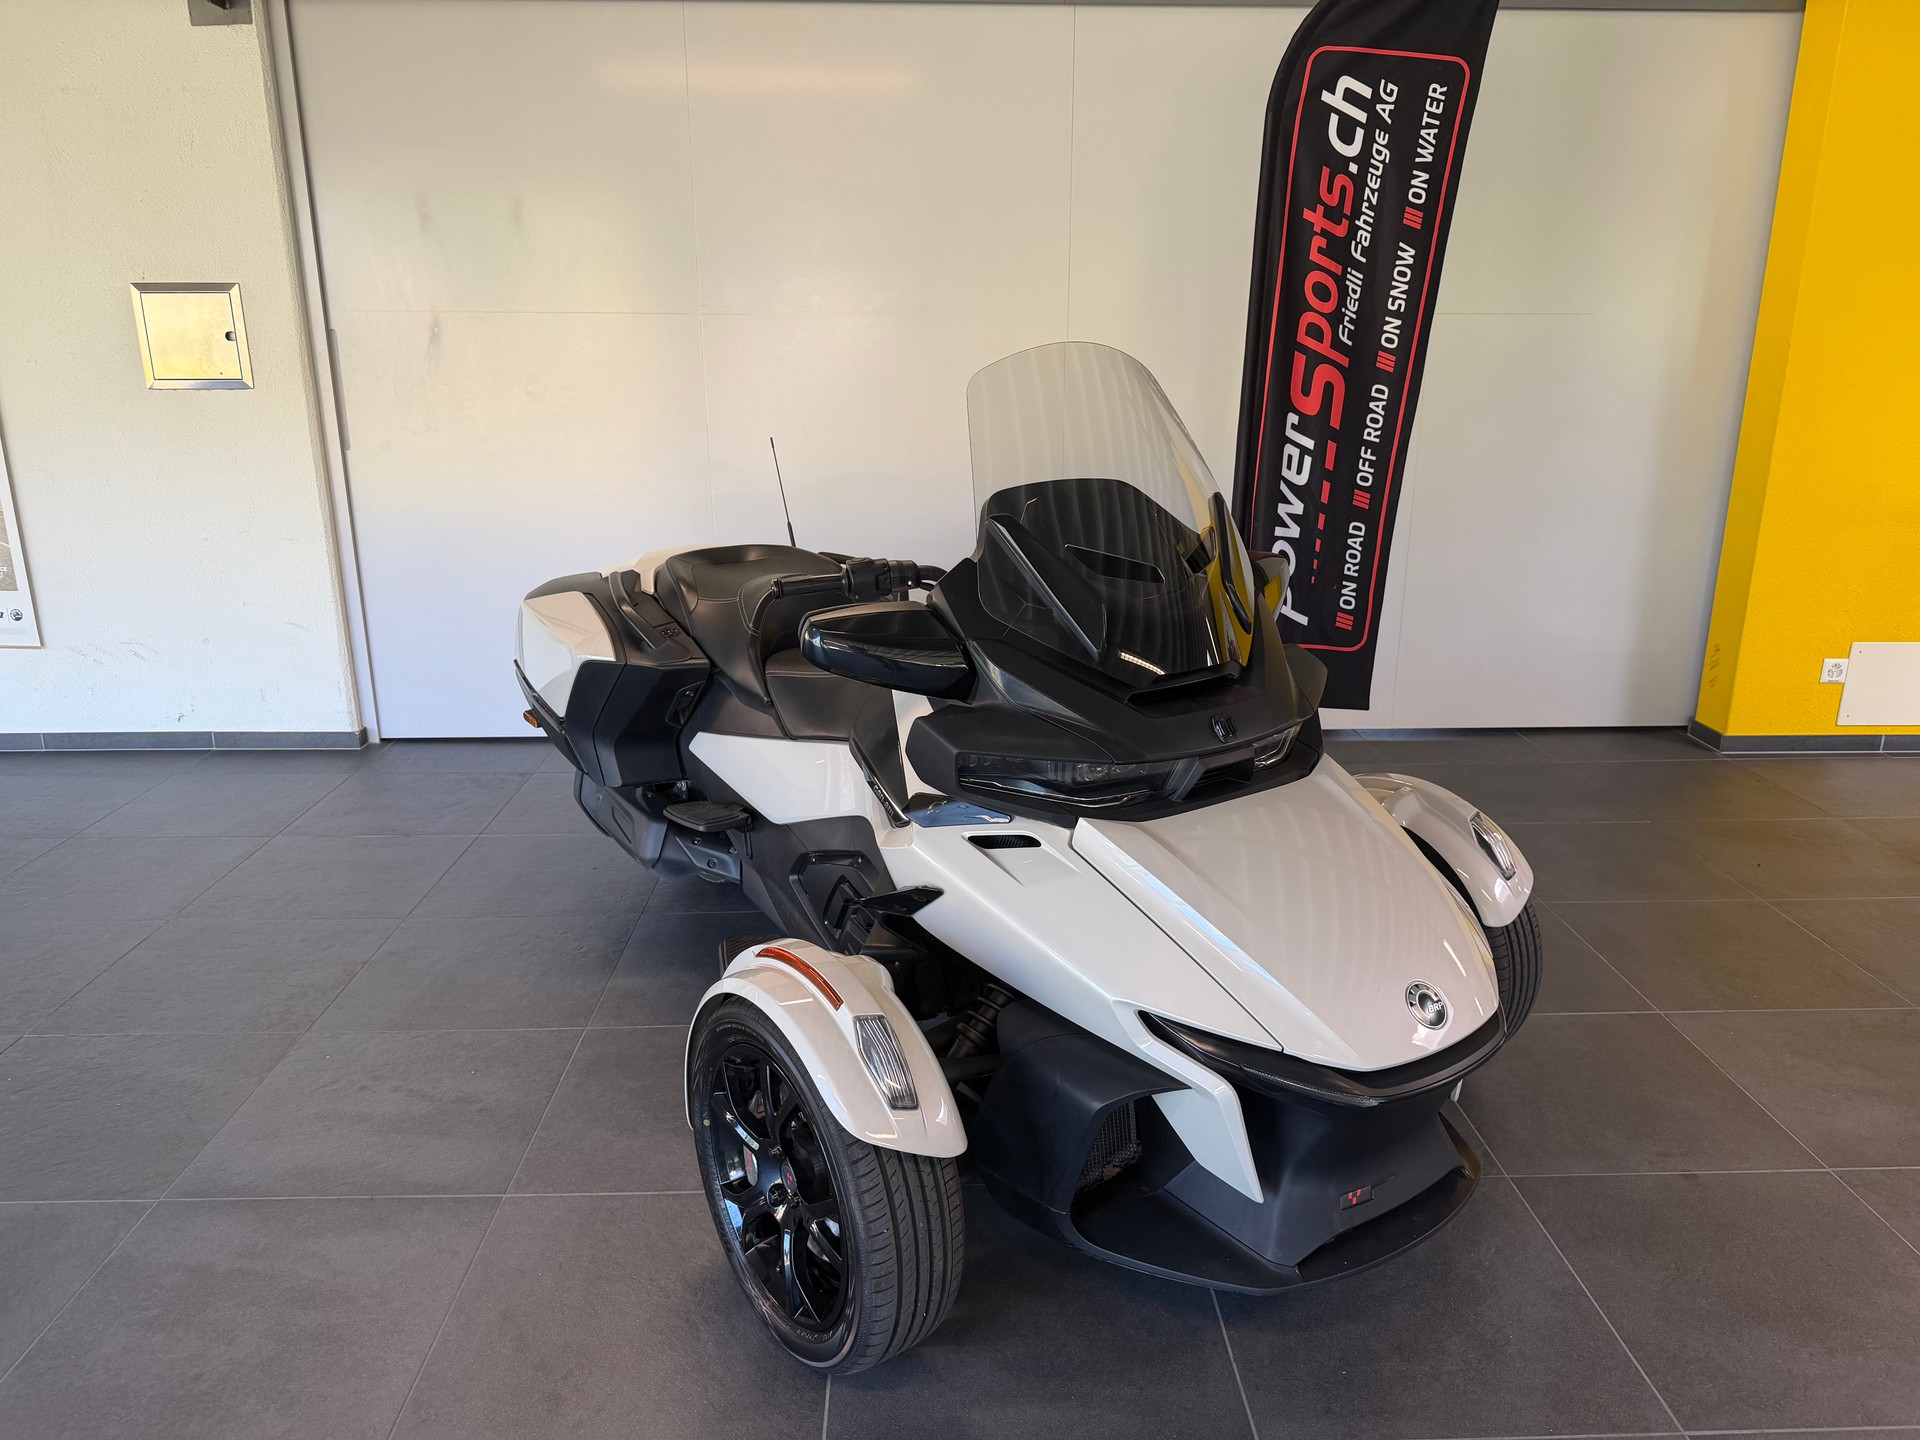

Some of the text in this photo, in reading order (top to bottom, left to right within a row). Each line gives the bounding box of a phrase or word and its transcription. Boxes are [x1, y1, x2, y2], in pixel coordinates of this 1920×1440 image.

[1339, 79, 1399, 346] Friedli Fahrzeuge AG
[1339, 82, 1448, 610] ON ROAD OFF ROAD ON SNOW ON WATER
[1428, 1002, 1443, 1013] BRP
